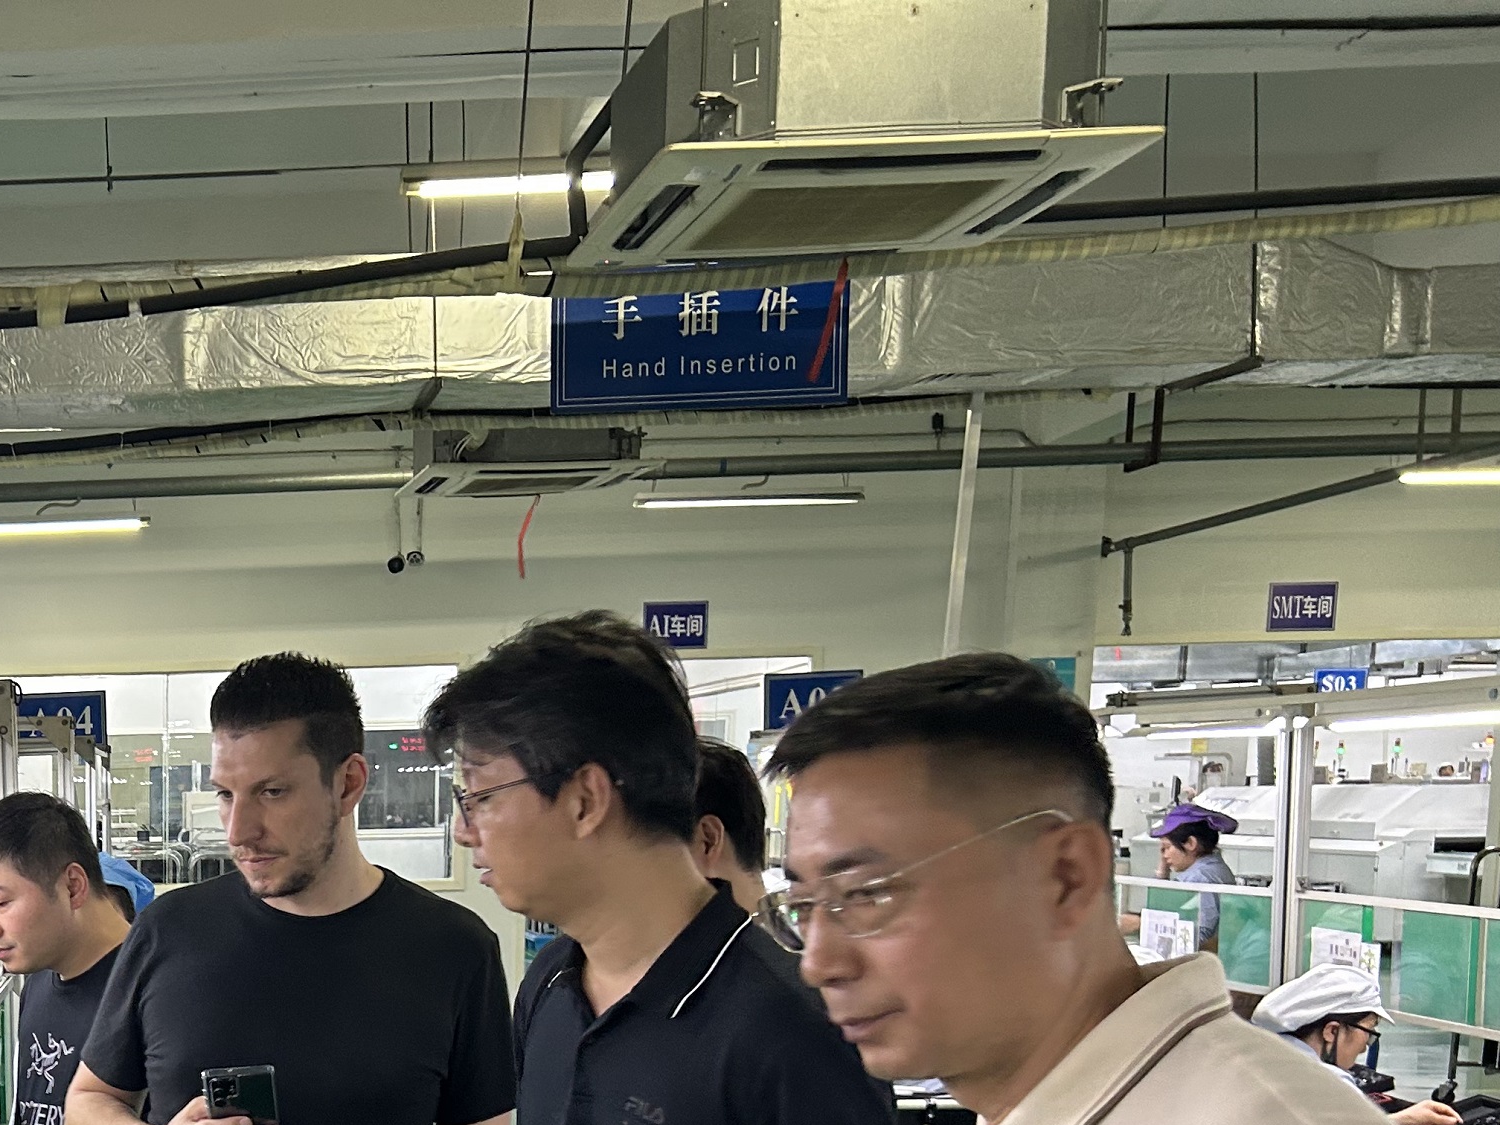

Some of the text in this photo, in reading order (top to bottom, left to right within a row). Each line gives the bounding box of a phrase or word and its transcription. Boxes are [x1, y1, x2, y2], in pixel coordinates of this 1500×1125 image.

[602, 286, 799, 340] 手插件
[602, 353, 797, 380] Hand Insertion
[1272, 595, 1334, 619] SMT车间
[649, 614, 704, 639] AI车间
[1321, 675, 1357, 693] S03
